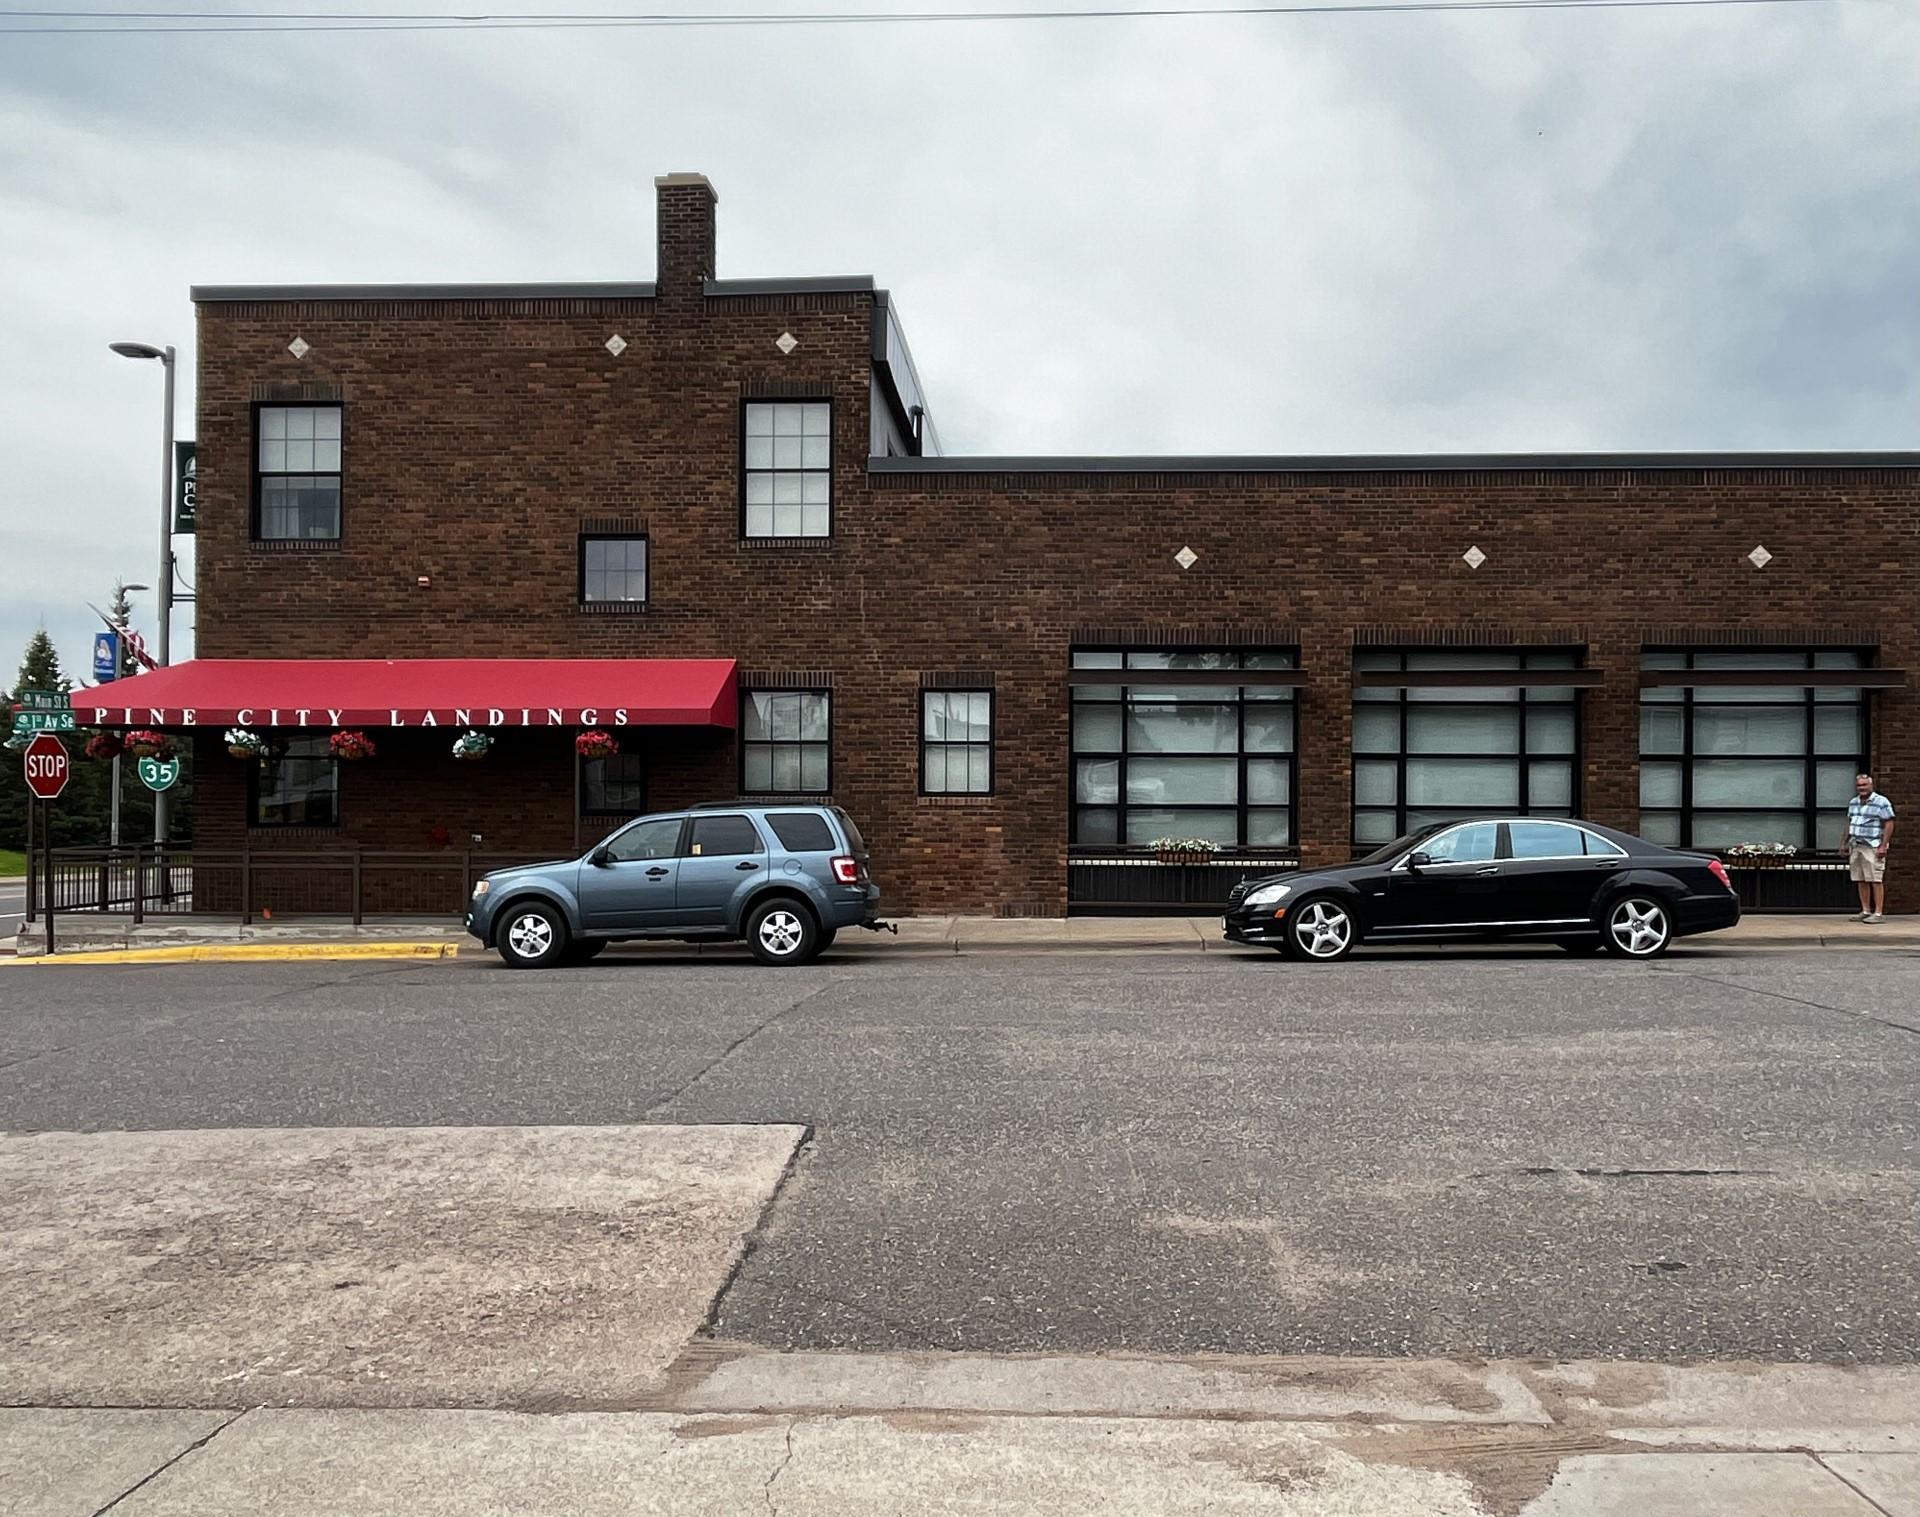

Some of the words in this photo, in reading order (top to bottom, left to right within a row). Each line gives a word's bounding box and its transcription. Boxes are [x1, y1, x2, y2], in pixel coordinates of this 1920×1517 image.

[44, 714, 58, 728] Av
[94, 707, 197, 726] PINE
[237, 708, 343, 726] CITY
[389, 708, 628, 726] LANDINGS
[28, 754, 66, 778] STOP
[144, 764, 173, 783] 35
